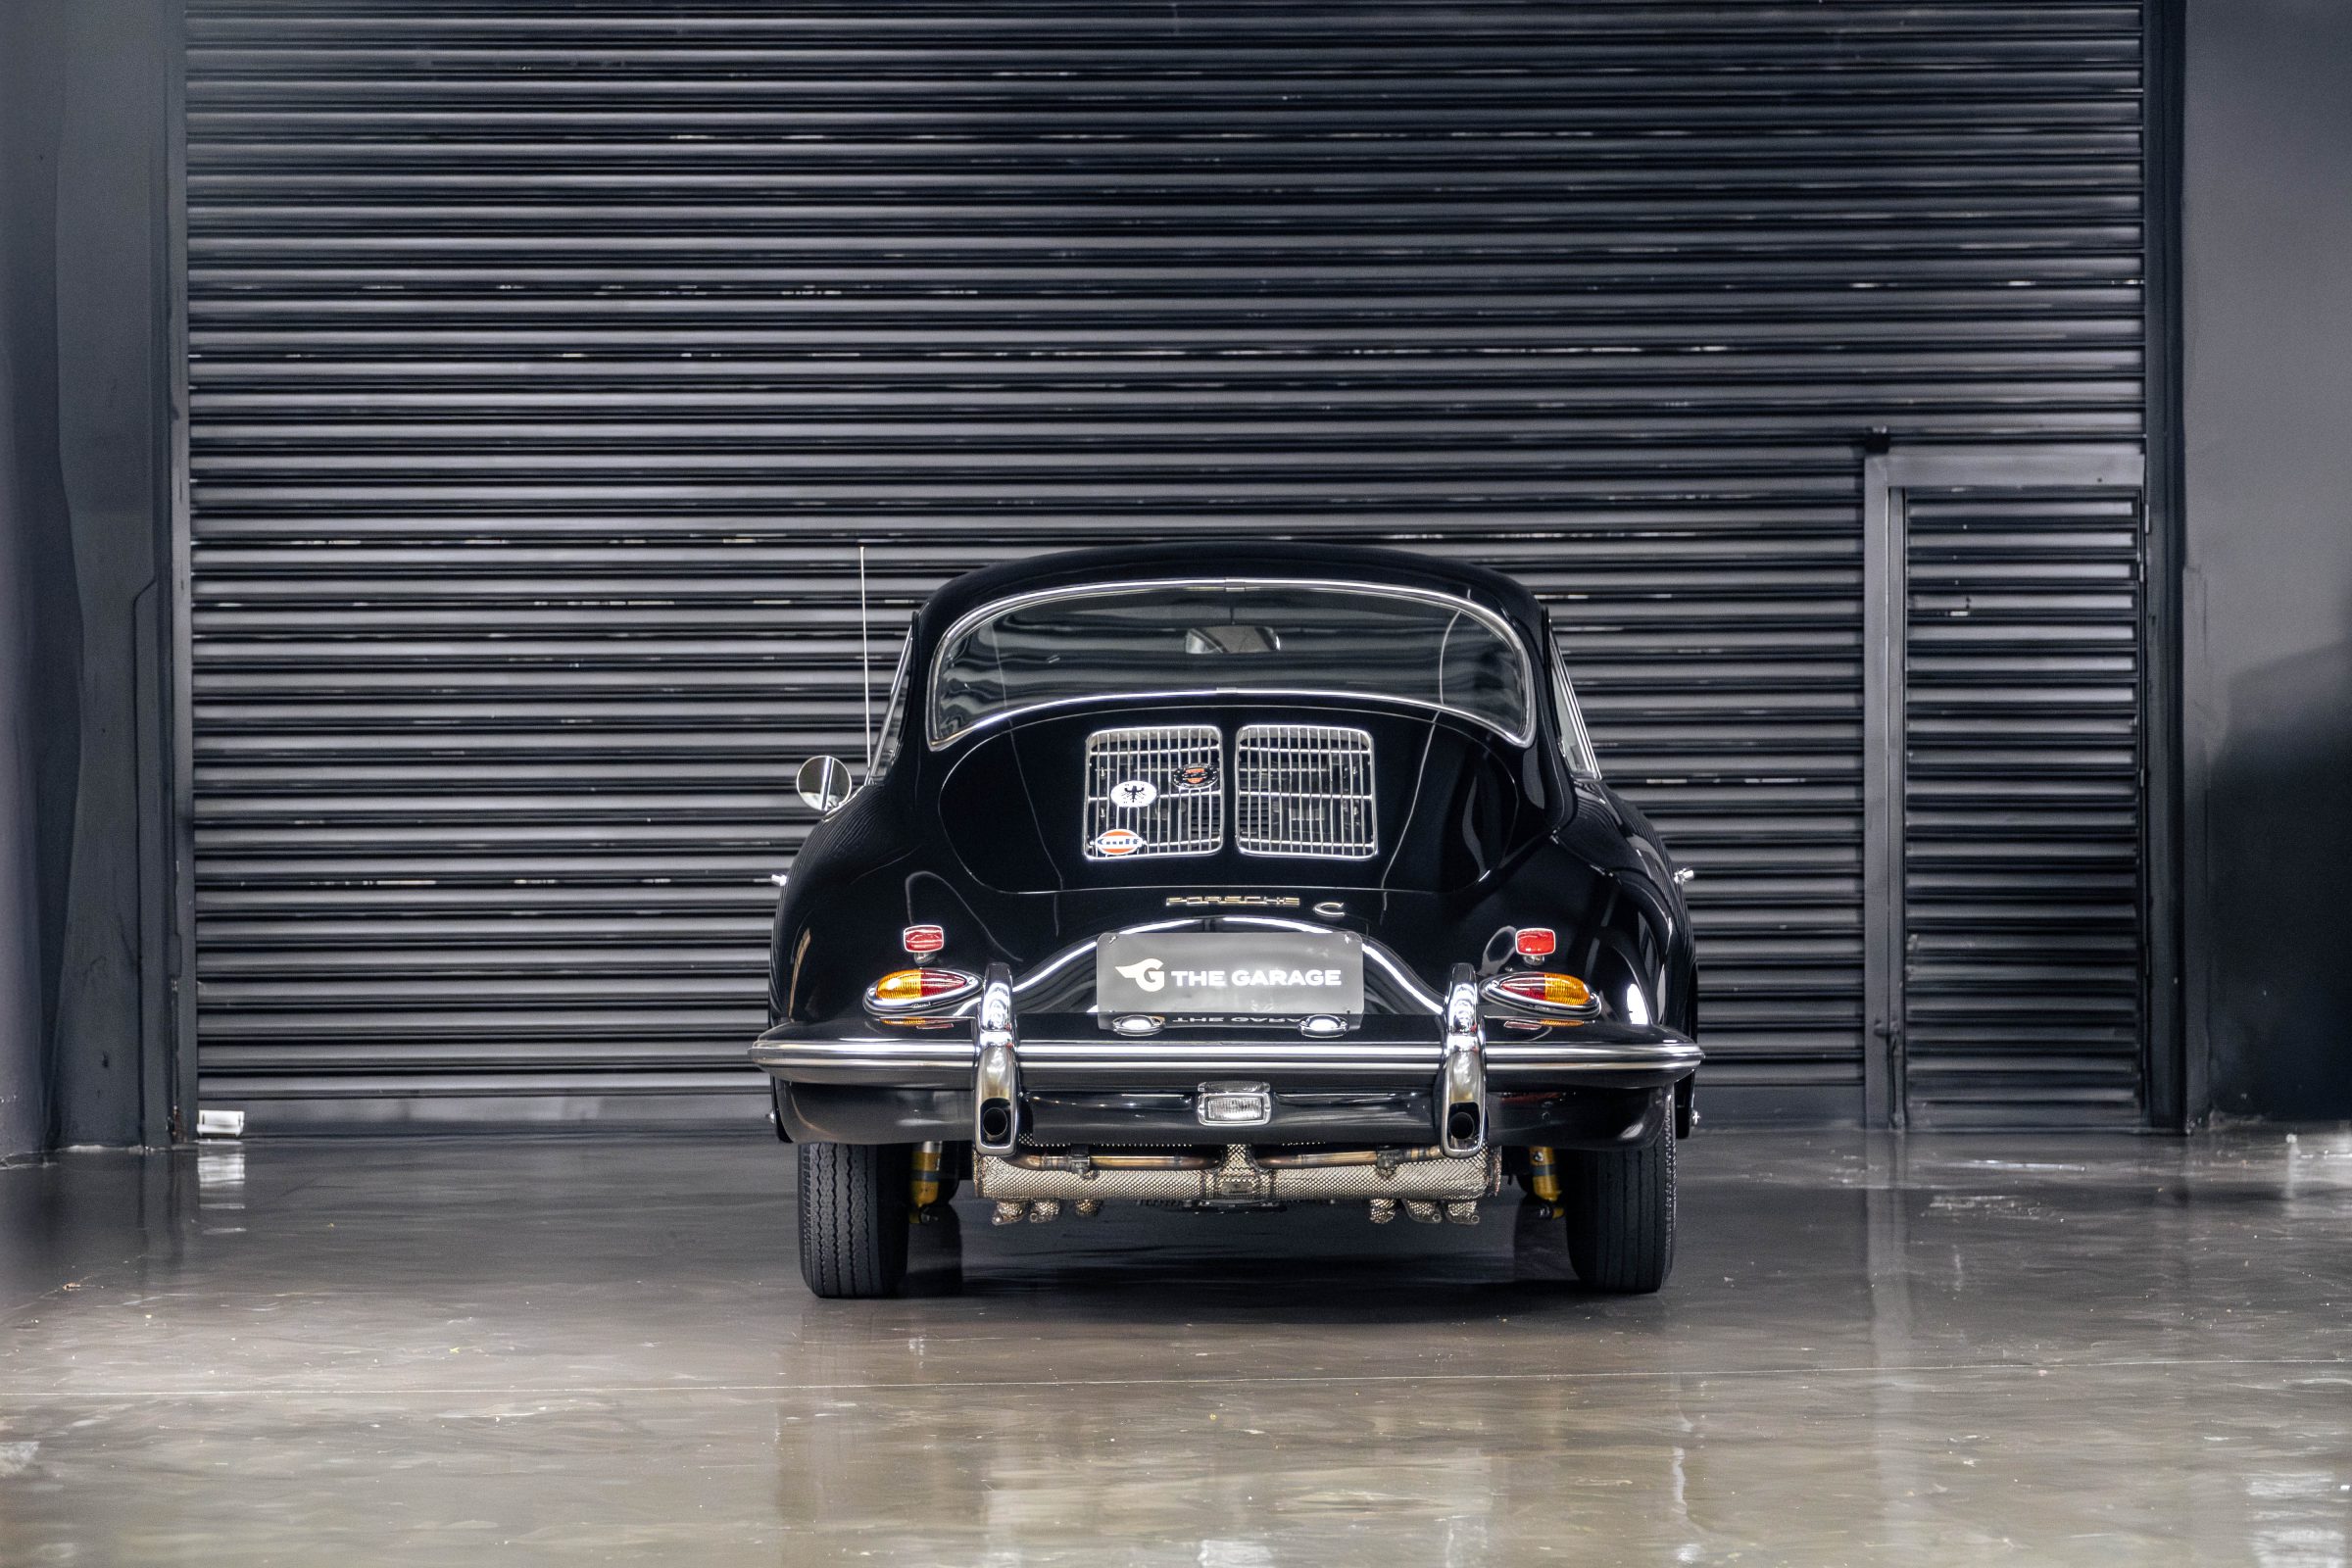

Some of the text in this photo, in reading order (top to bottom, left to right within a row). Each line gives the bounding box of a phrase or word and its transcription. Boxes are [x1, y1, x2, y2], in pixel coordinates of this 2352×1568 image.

[1166, 896, 1346, 917] PORSCHE C
[1171, 970, 1226, 987] THE
[1231, 969, 1342, 987] GARAGE
